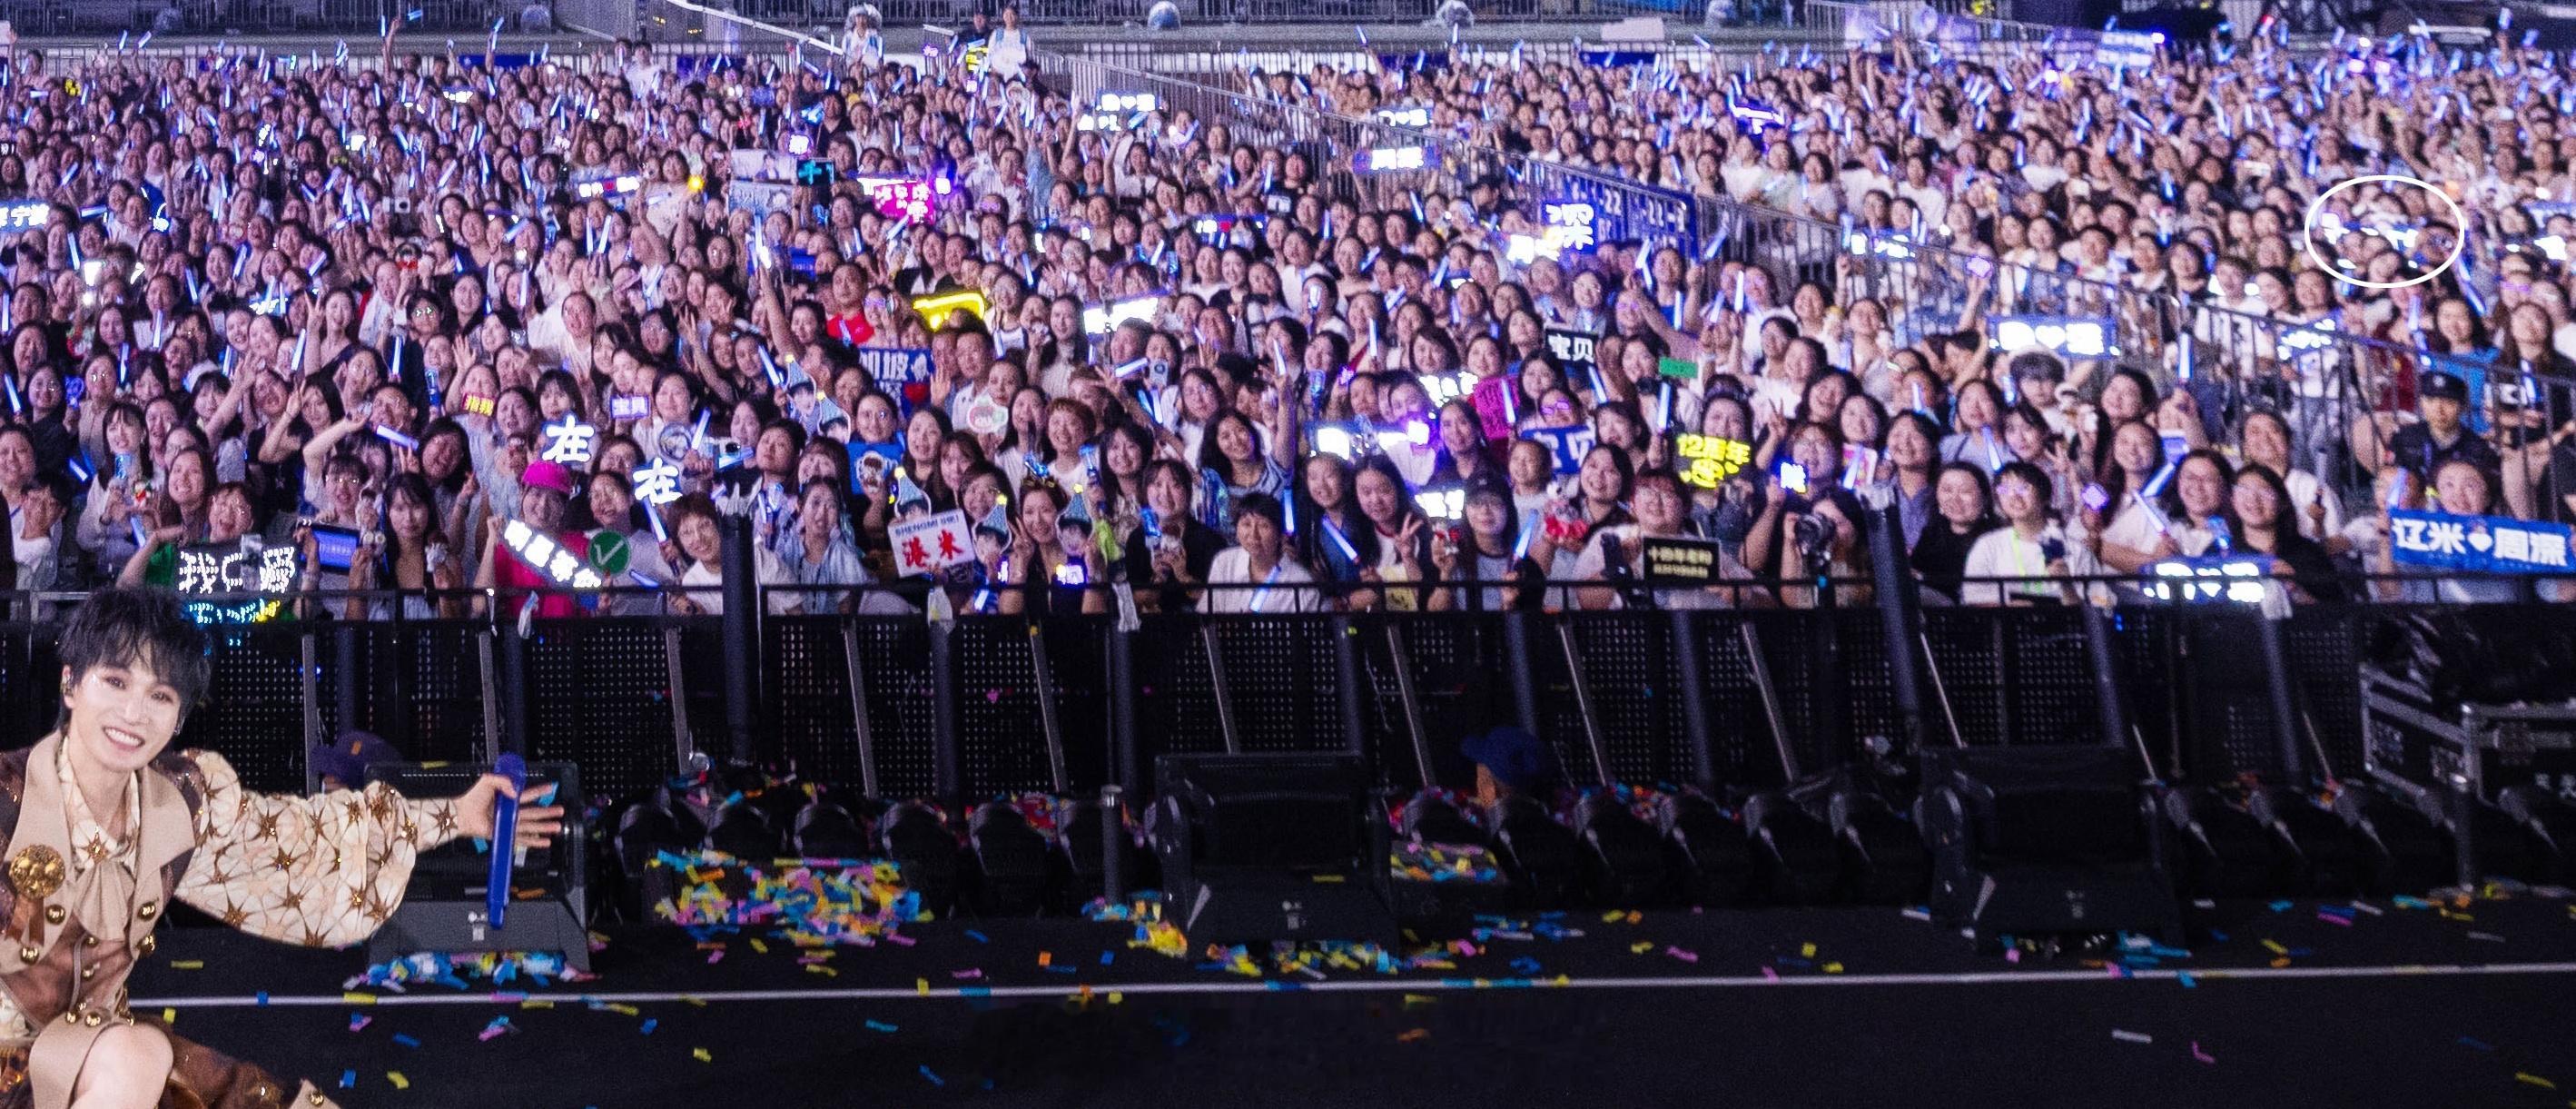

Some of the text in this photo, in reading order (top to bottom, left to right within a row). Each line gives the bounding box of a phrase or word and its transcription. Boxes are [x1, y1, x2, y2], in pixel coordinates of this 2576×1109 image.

[1548, 334, 1594, 363] 宝贝
[542, 414, 595, 463] 在
[633, 457, 682, 505] 在
[2392, 518, 2467, 554] 辽米
[2493, 528, 2568, 566] 周深
